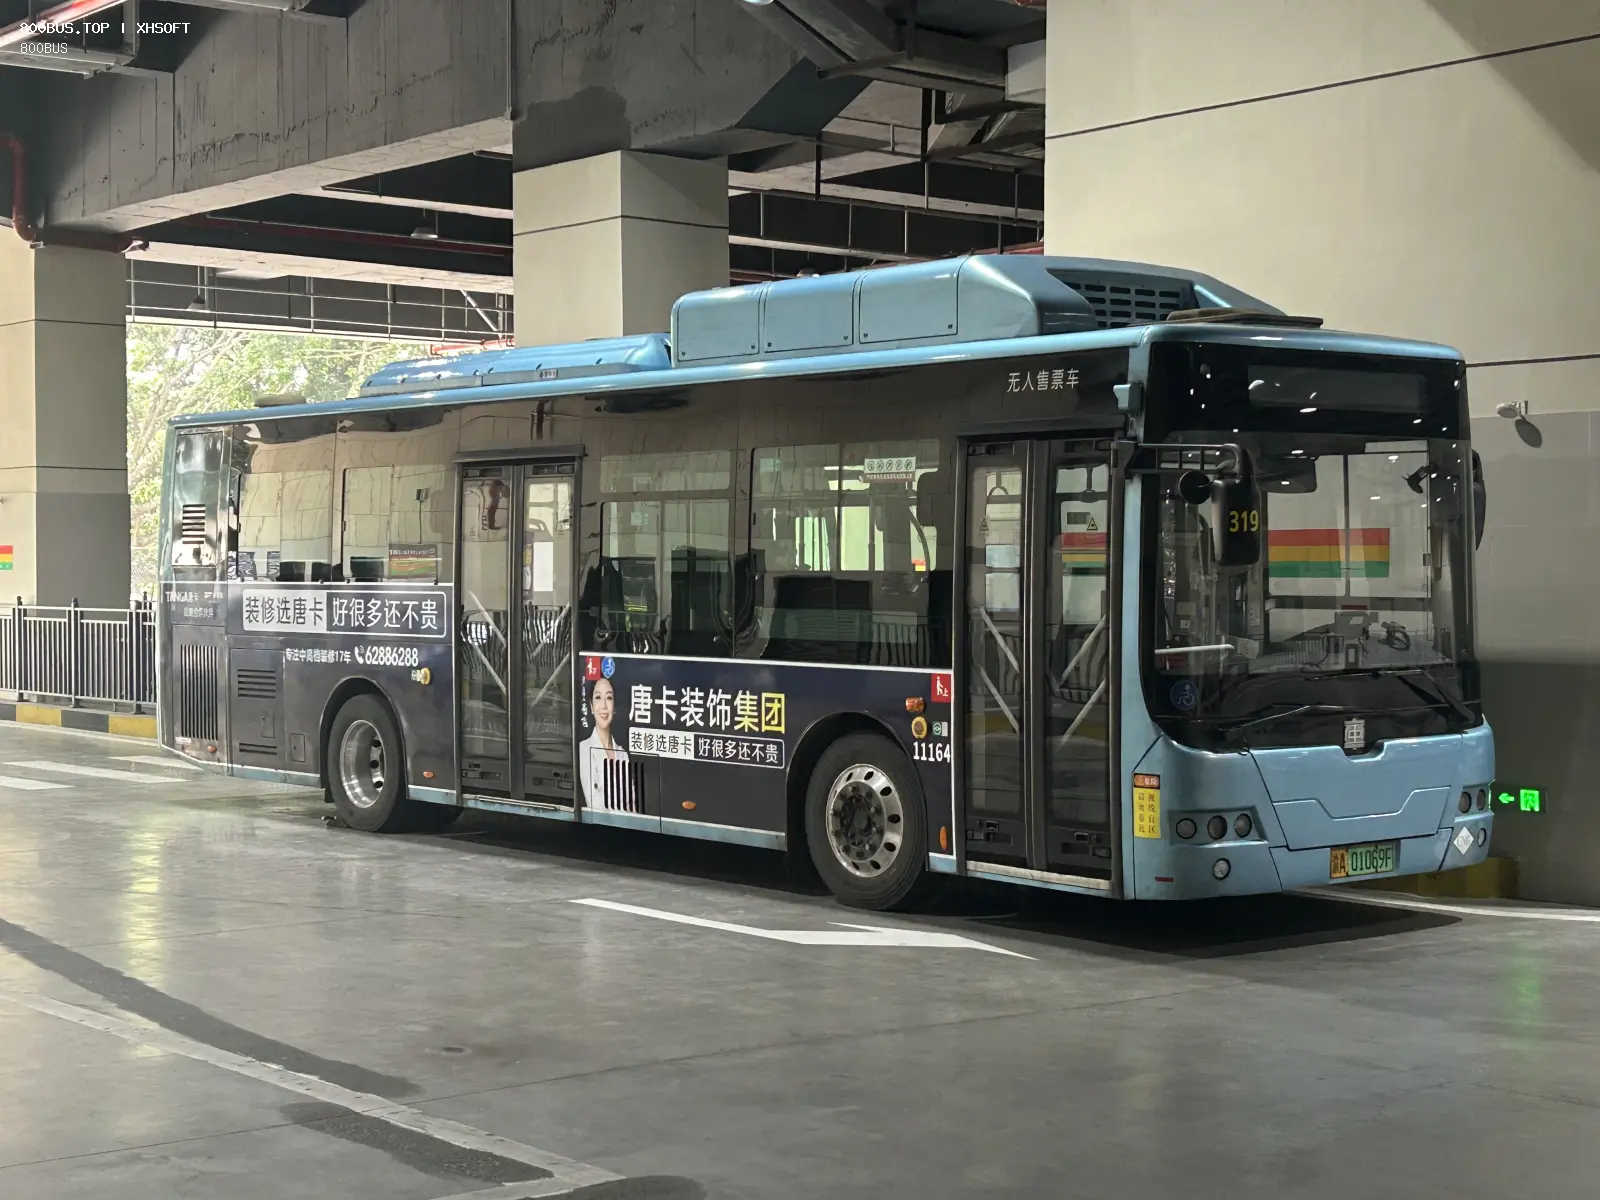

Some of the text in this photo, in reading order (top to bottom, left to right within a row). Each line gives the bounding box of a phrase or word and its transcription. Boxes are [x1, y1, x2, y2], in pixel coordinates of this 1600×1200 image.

[1006, 367, 1080, 393] 无人售票车
[1228, 509, 1259, 533] 319
[245, 596, 325, 627] 装修选唐卡
[332, 598, 438, 630] 好很多还不贵
[364, 645, 419, 667] 62886288
[628, 683, 786, 735] 唐卡装饰集团
[630, 731, 779, 764] 装修选唐卡 好很多还不贵
[913, 741, 951, 763] 11164
